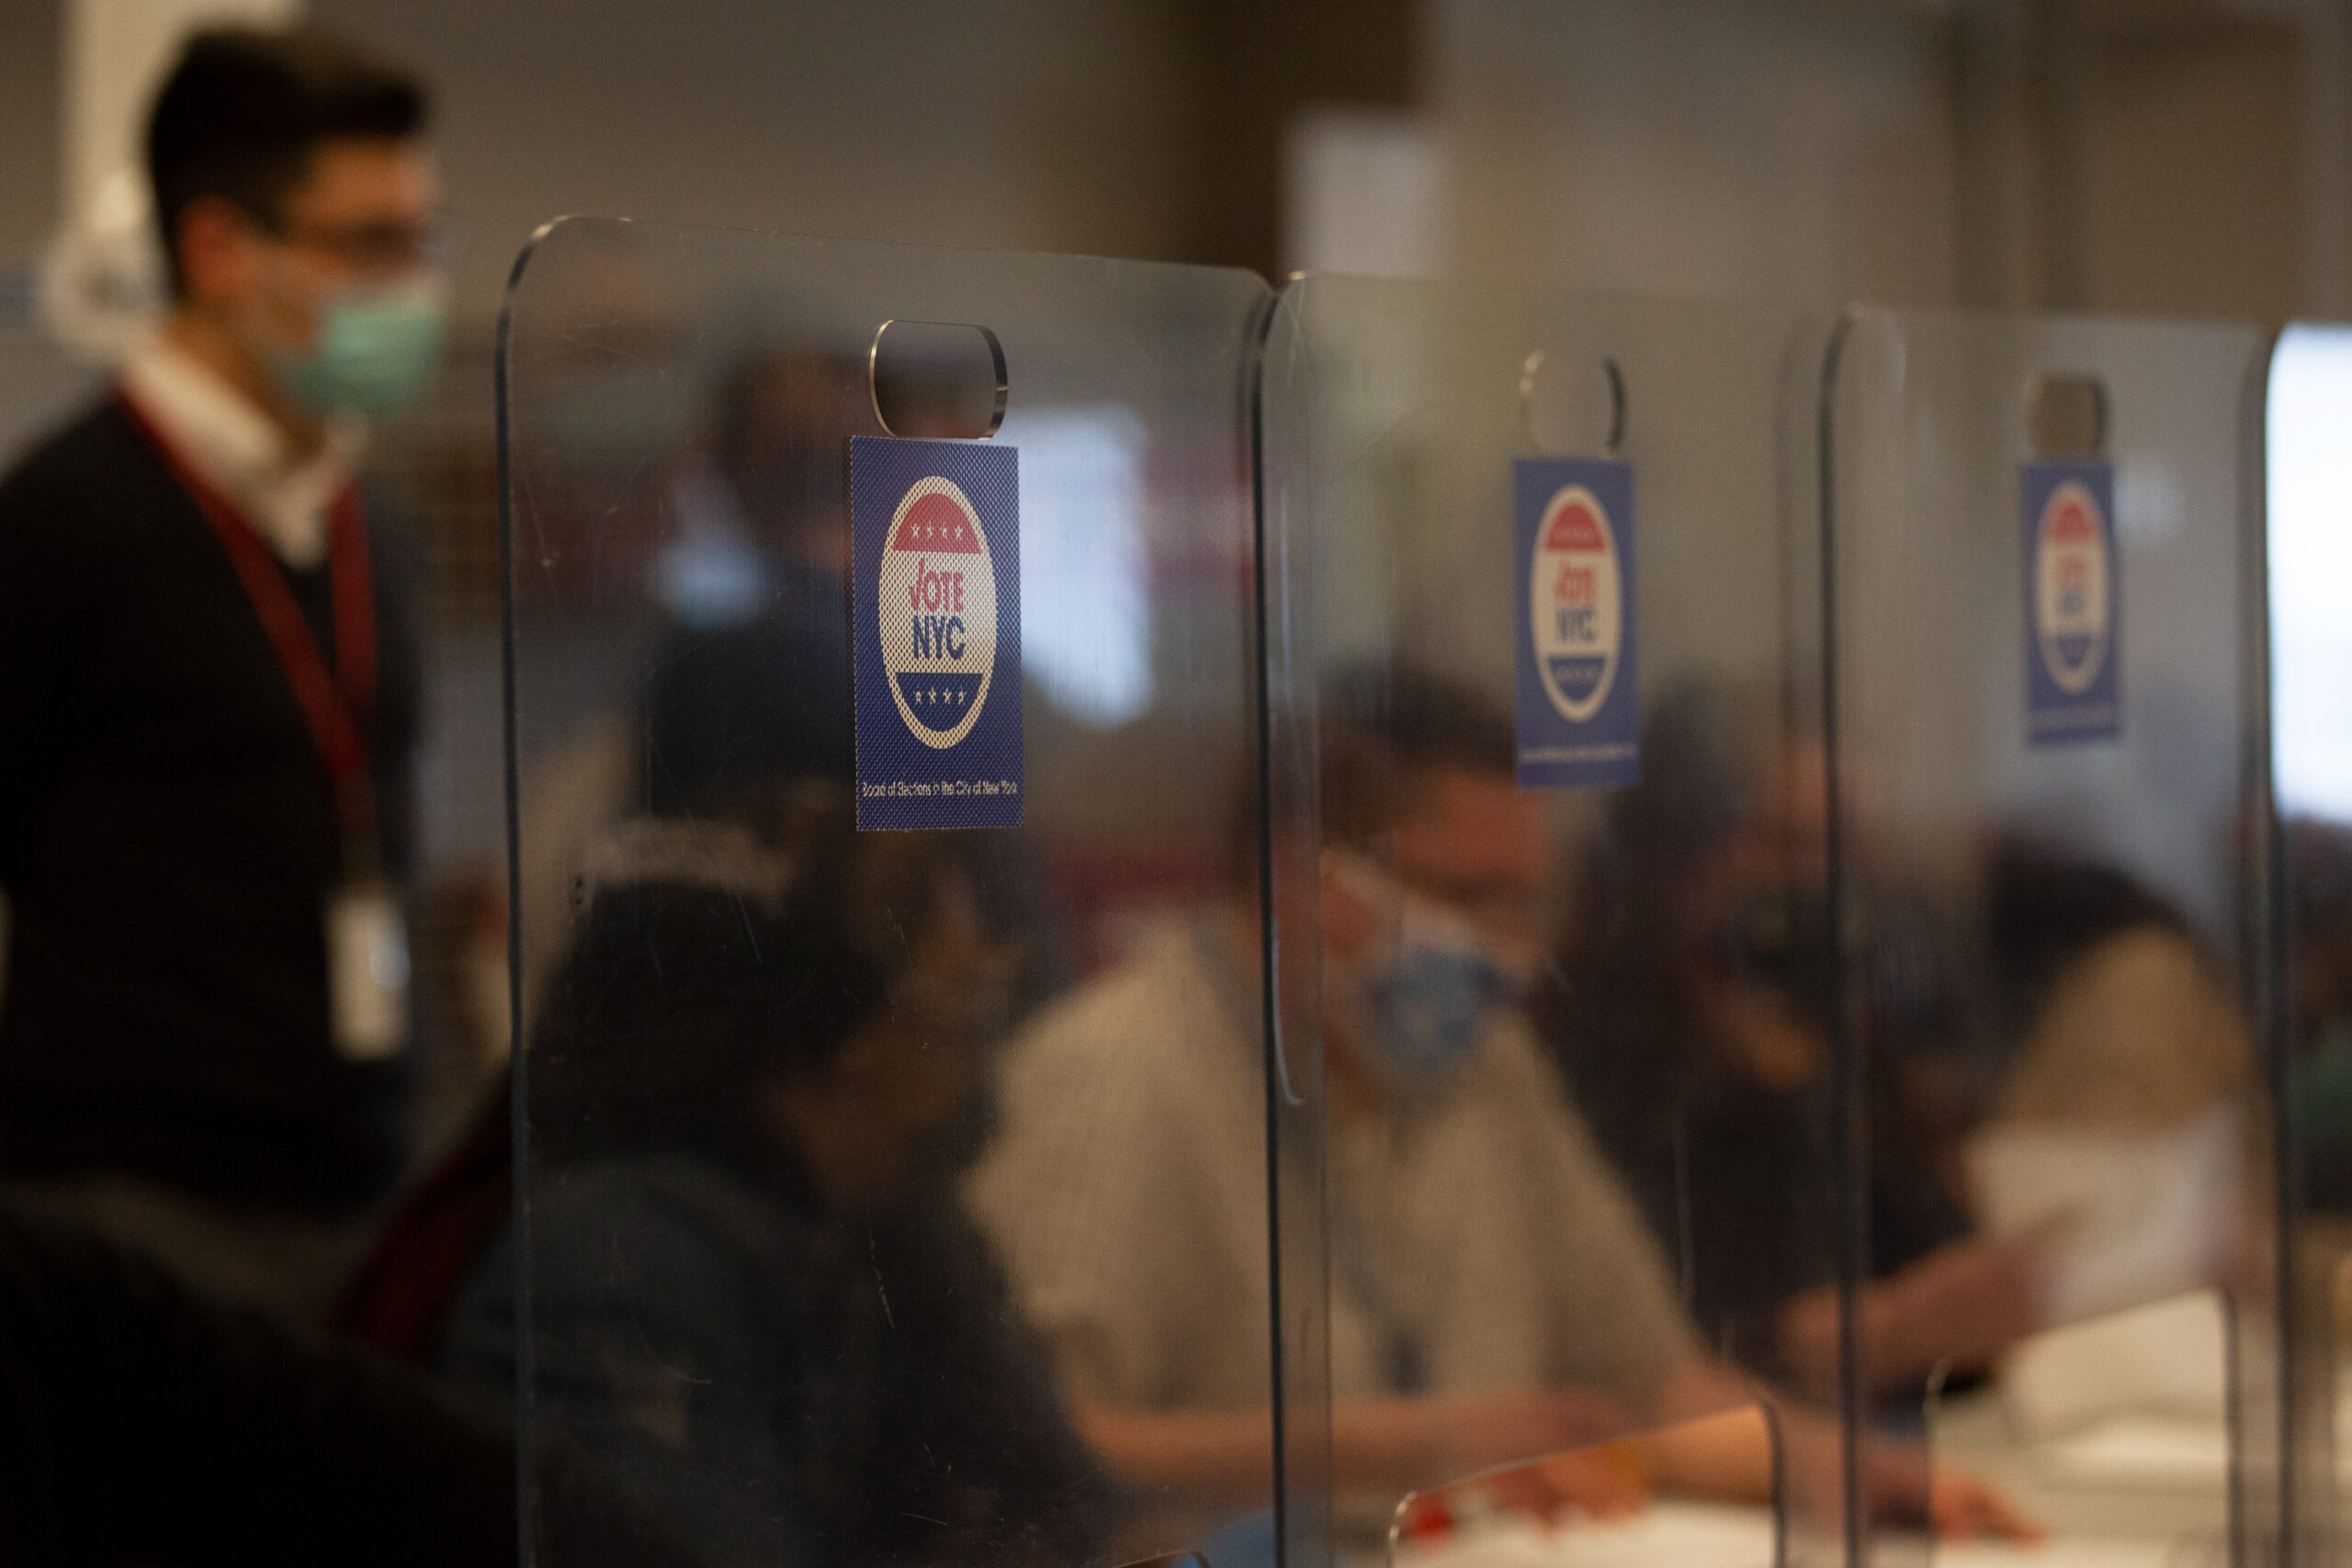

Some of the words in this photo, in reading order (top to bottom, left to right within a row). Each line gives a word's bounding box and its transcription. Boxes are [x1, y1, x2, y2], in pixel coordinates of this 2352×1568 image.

[909, 558, 963, 612] VOTE
[913, 615, 966, 660] NYC
[888, 781, 896, 796] of
[898, 781, 932, 796] Elections
[942, 781, 954, 795] the
[956, 780, 971, 797] City
[973, 780, 981, 795] of
[982, 780, 1000, 795] New
